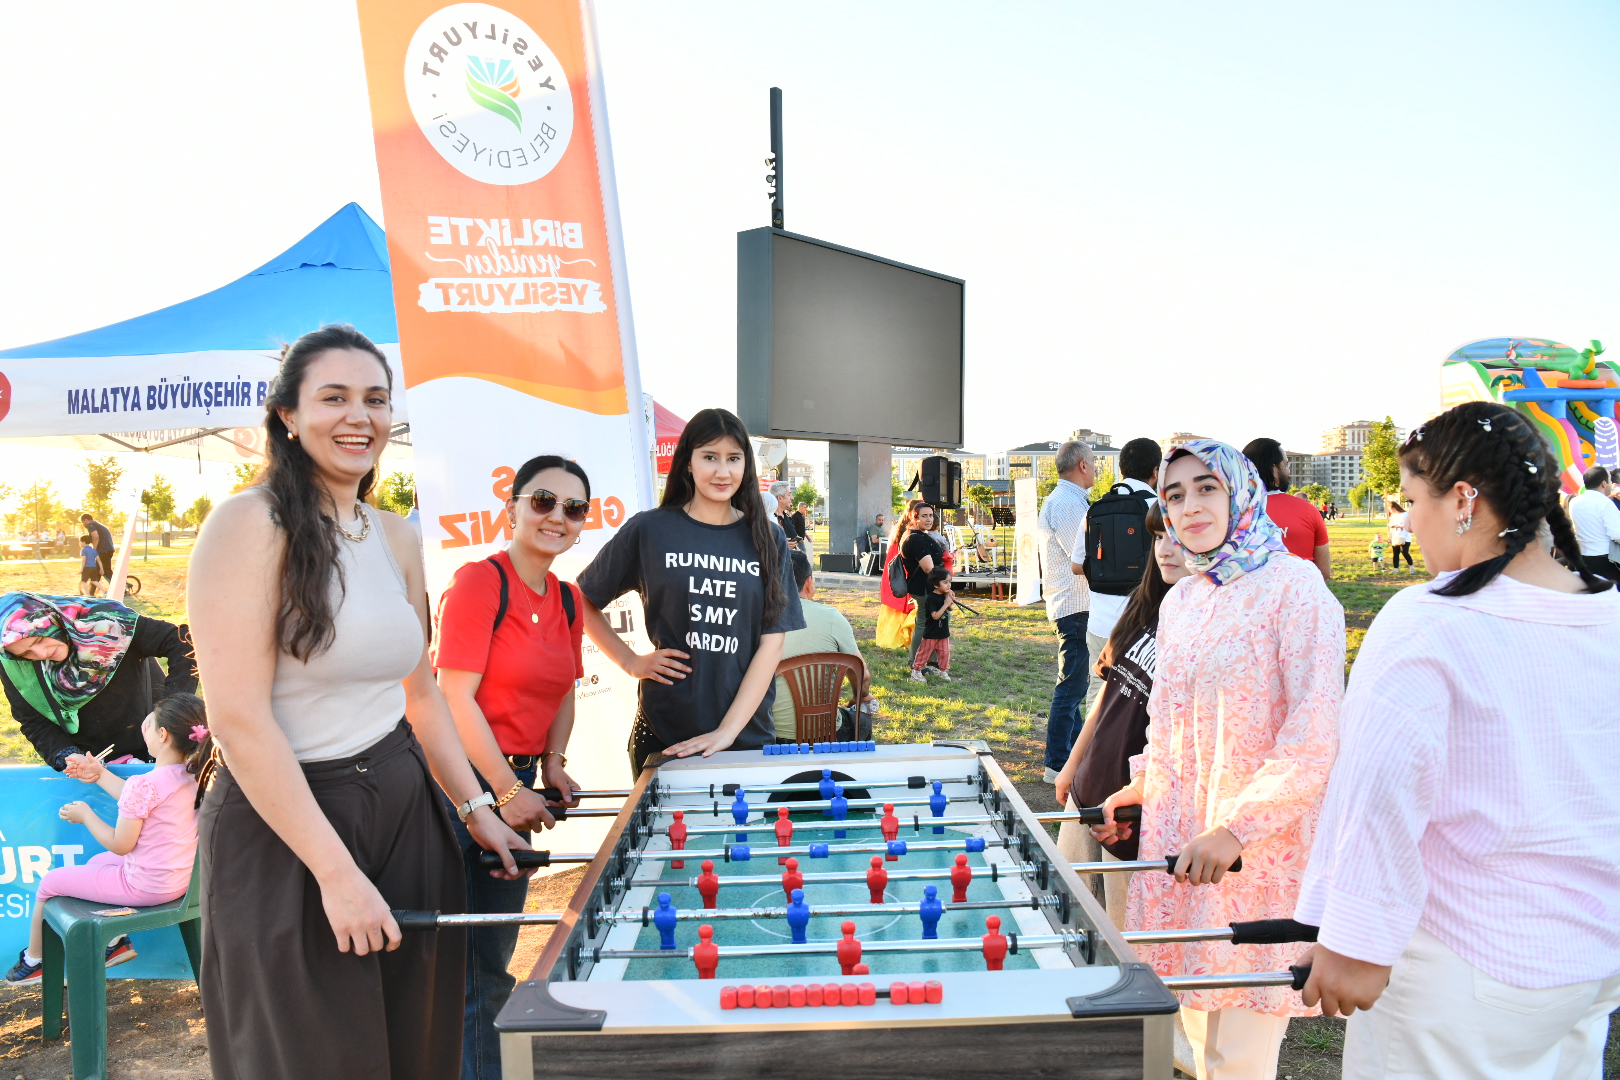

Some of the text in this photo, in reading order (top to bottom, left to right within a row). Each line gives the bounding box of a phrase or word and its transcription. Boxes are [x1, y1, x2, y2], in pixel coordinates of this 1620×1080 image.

[67, 386, 141, 414] MALATYA
[146, 375, 252, 416] BÜYÜKŞEHİR
[665, 552, 760, 577] RUNNING
[689, 576, 737, 599] LATE
[688, 603, 738, 626] S MY
